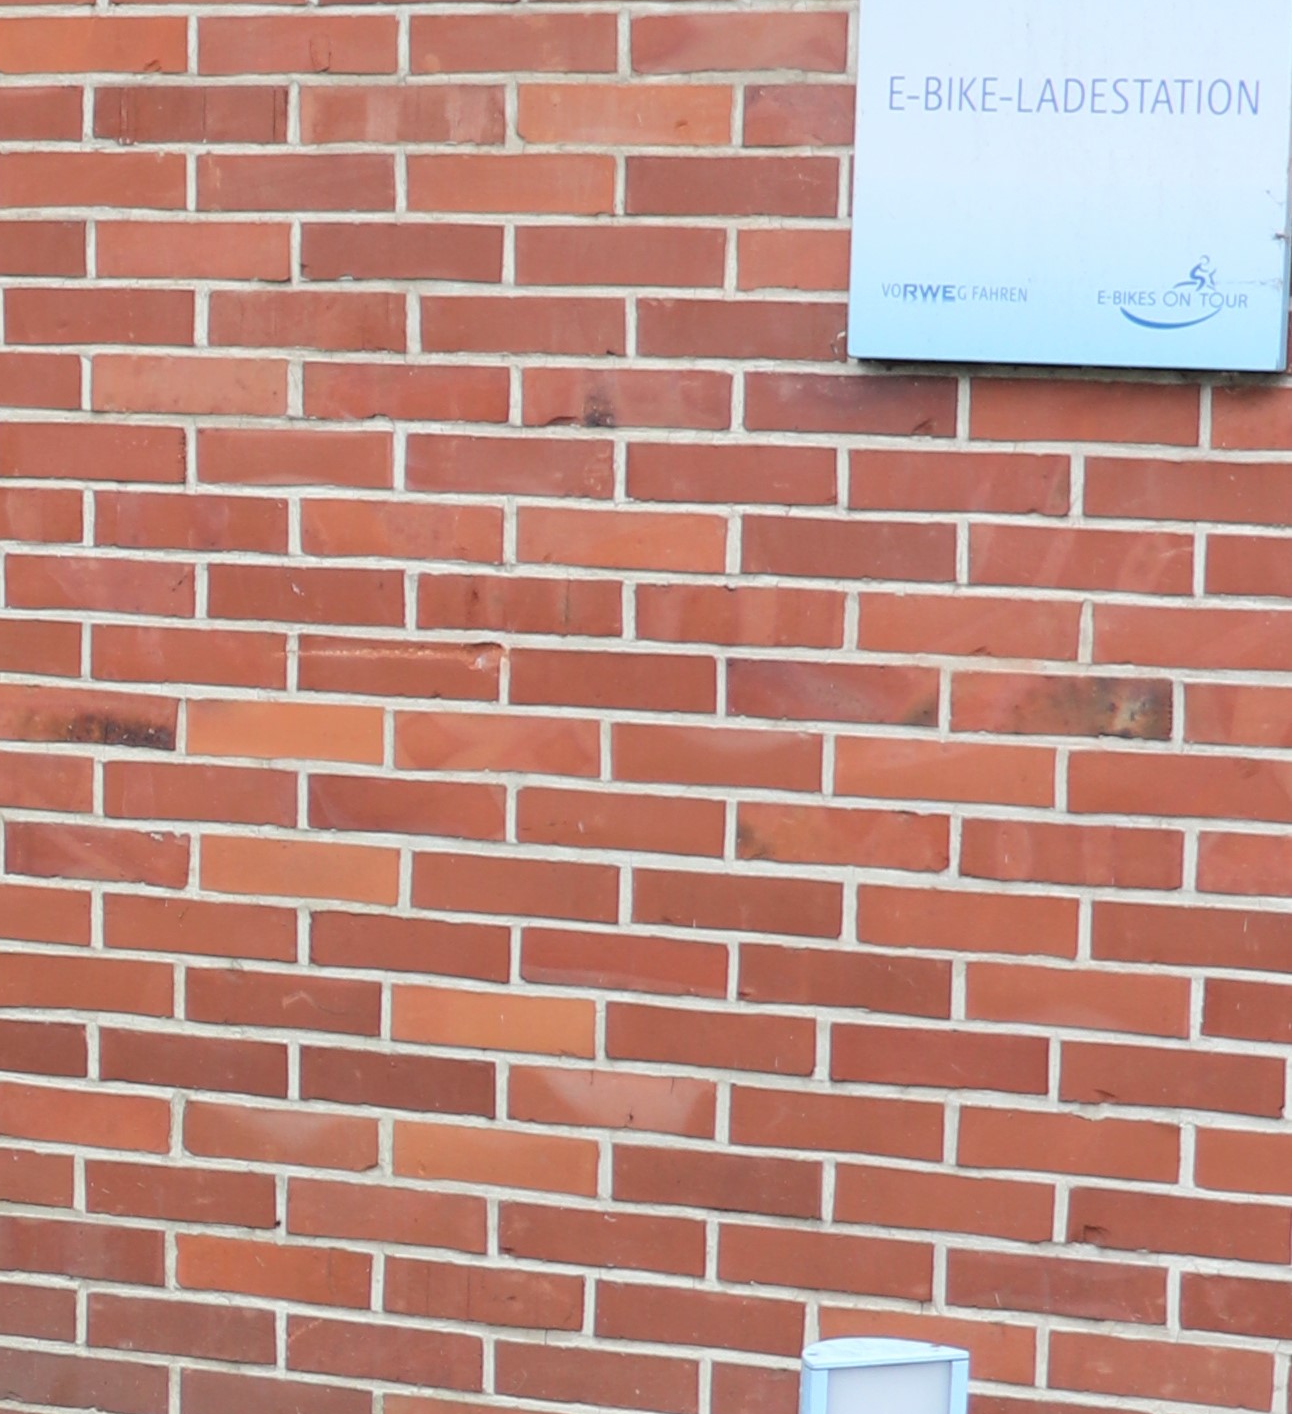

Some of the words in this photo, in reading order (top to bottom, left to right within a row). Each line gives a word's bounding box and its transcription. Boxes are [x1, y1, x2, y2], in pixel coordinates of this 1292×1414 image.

[887, 75, 1261, 116] E-BIKE-LADESTATION
[972, 285, 1028, 303] FAHREN
[1097, 289, 1156, 307] E-BIKES
[1163, 290, 1191, 308] ON
[1201, 290, 1249, 309] TOUR
